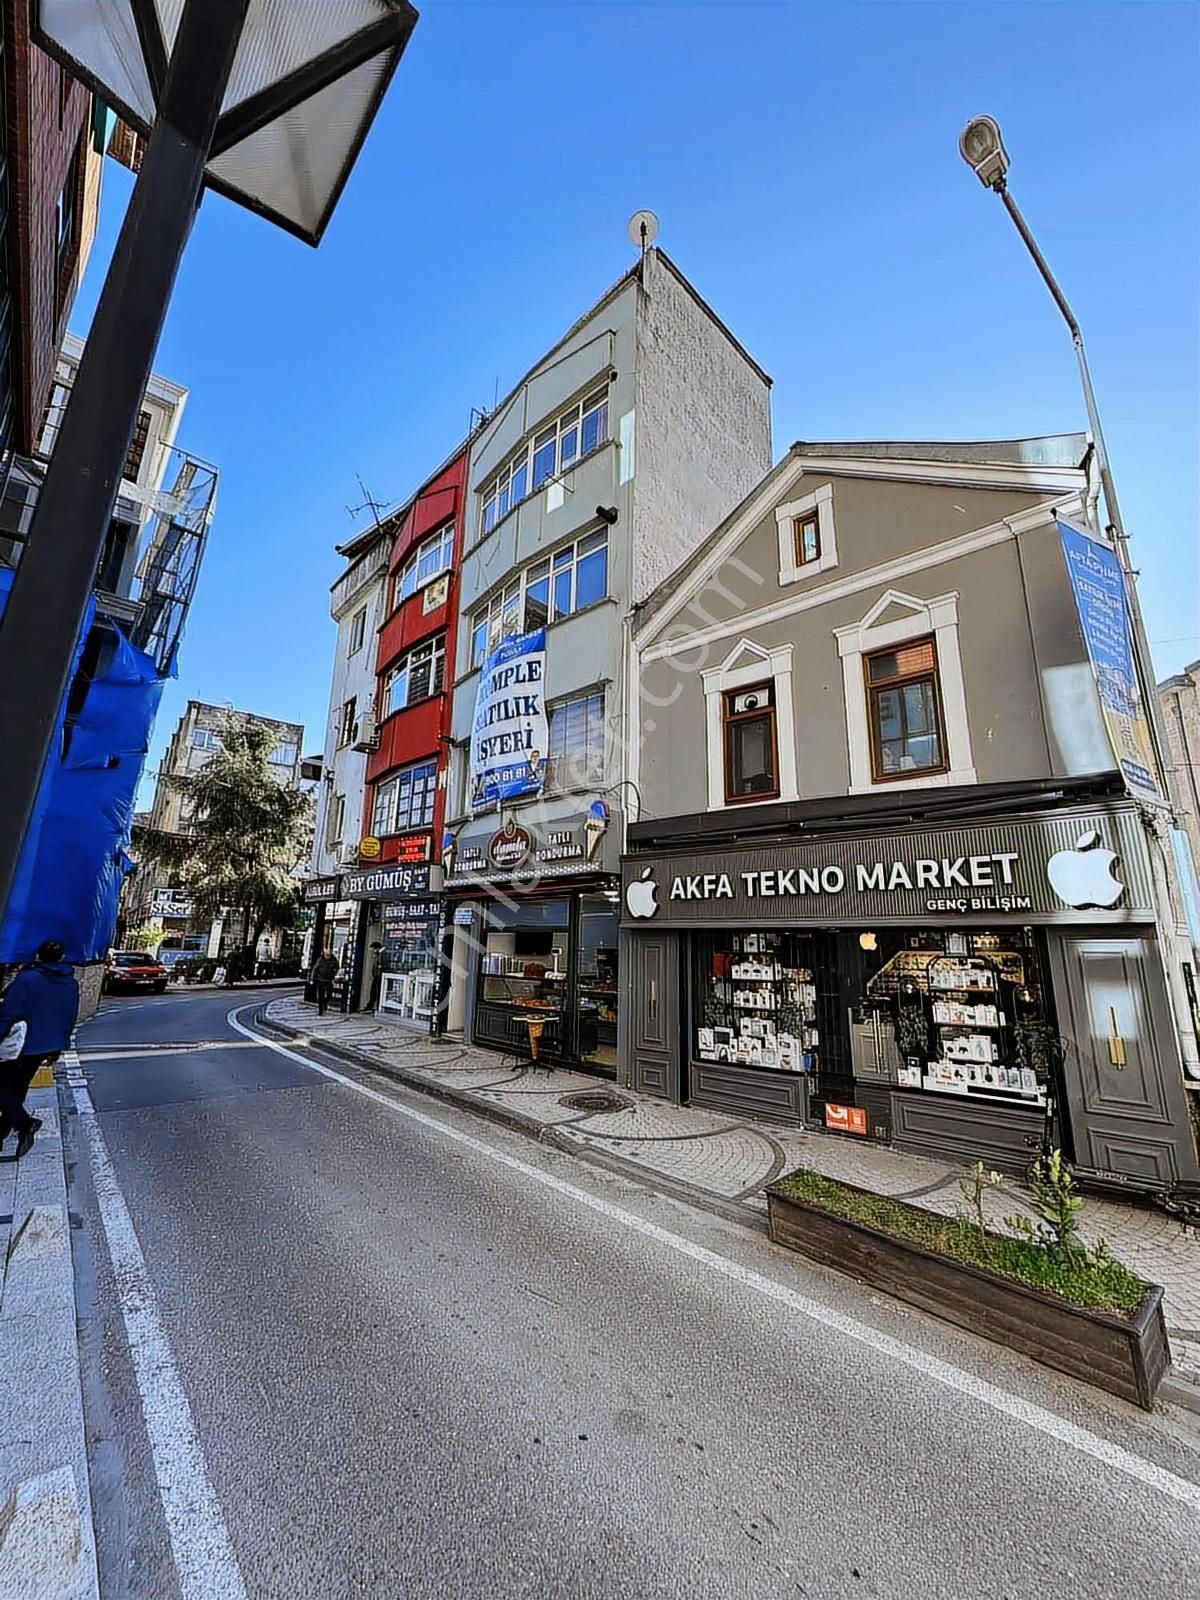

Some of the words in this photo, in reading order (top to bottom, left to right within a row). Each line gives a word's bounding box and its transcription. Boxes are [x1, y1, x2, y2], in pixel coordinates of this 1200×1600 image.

[474, 693, 541, 733] SATILIK
[476, 720, 534, 767] İŞYERİ
[549, 831, 571, 845] TATLI
[535, 844, 582, 862] DONDURMA
[349, 876, 365, 893] BY
[366, 866, 412, 892] GÜMÜŞ
[670, 873, 734, 900] AKFA
[741, 865, 845, 898] TEKNO
[856, 852, 1019, 892] MARKET
[926, 898, 967, 913] GENÇ
[971, 894, 1031, 912] BİLİŞİM
